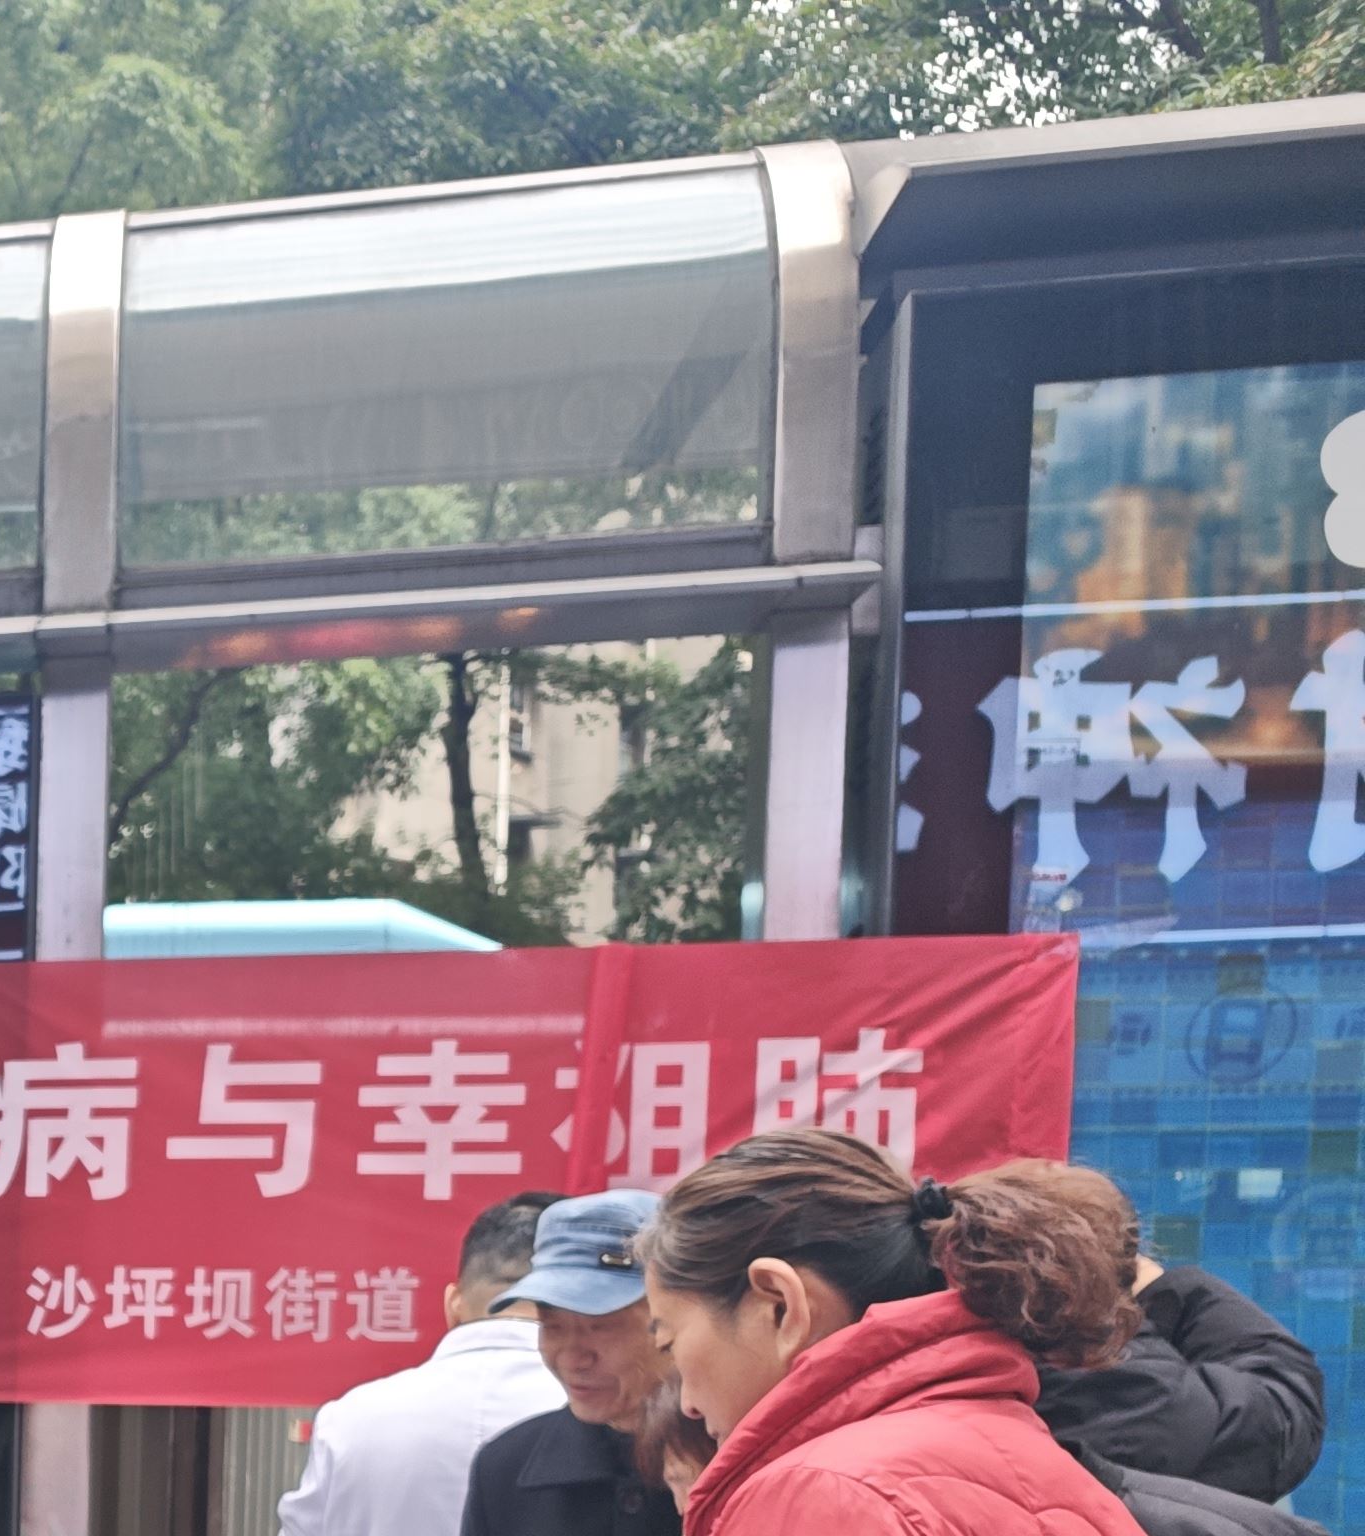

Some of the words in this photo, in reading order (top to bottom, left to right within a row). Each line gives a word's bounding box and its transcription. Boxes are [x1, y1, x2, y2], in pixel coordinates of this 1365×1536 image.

[26, 1264, 422, 1343] 沙坪坝街道
